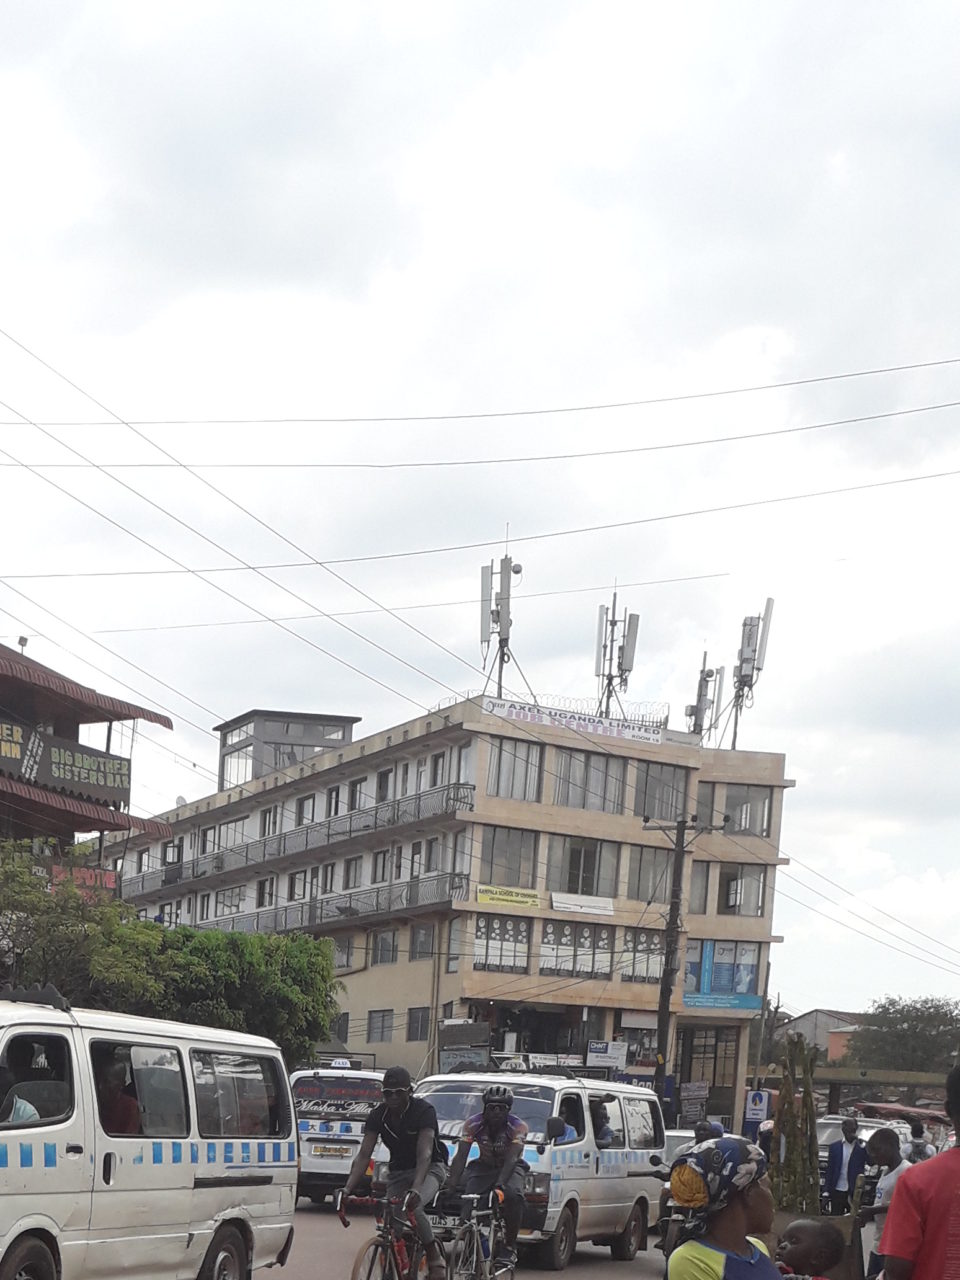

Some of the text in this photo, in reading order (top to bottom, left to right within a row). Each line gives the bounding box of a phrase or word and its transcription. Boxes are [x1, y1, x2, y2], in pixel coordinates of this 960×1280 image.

[506, 708, 626, 738] JOB CENTRE
[508, 703, 544, 715] AXEL
[548, 710, 604, 726] UGANDA
[608, 721, 661, 736] LIMITED
[50, 747, 74, 766] BIG
[73, 752, 130, 775] BROTHER
[51, 763, 105, 787] SISTERS
[296, 1100, 381, 1114] Masha Alla
